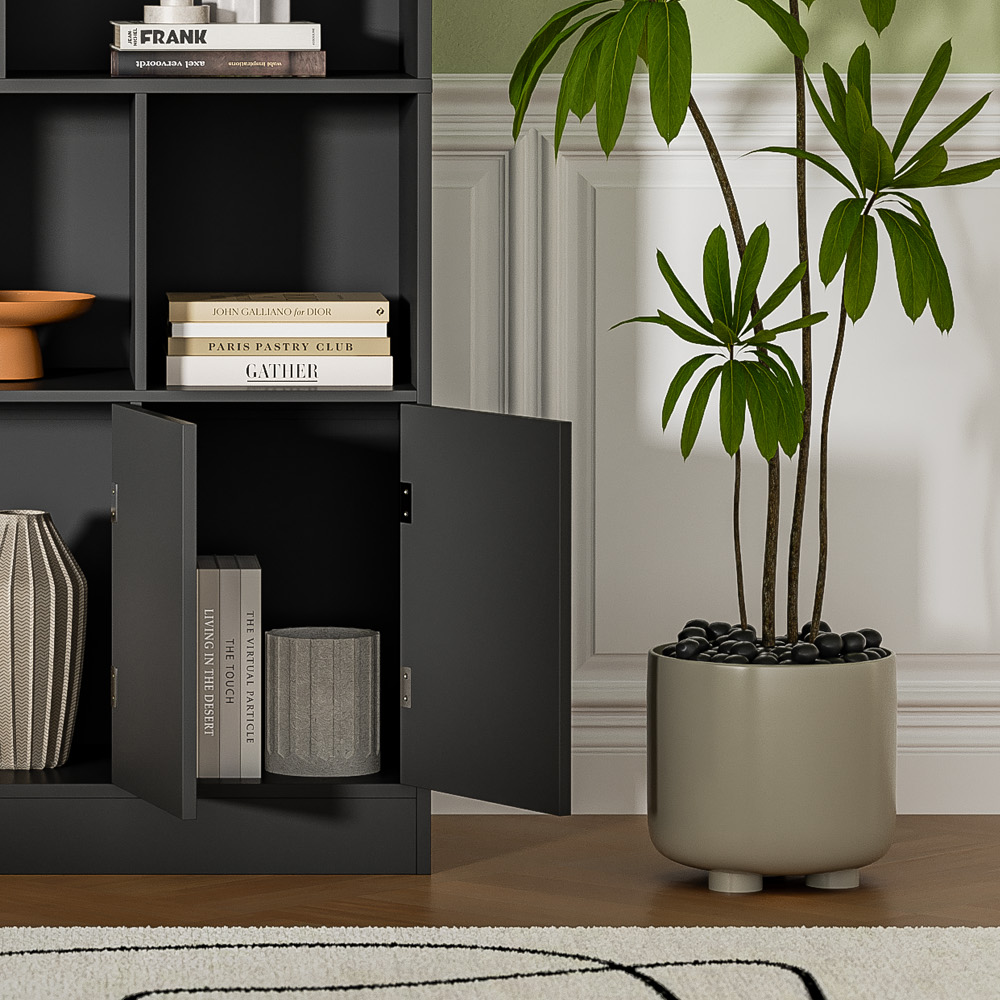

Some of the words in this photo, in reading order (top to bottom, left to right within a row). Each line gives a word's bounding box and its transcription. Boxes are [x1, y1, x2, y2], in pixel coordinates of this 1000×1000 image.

[140, 29, 207, 44] FRANK
[136, 60, 182, 68] vervoordt
[185, 60, 205, 68] axel
[212, 308, 239, 316] JOHN
[241, 308, 292, 316] GALLIANO
[294, 308, 305, 317] for
[307, 308, 332, 316] DIOR
[208, 343, 250, 351] PARIS
[256, 343, 309, 351] PASTRY
[316, 343, 353, 351] CLUB
[246, 363, 318, 378] GATHER
[204, 609, 214, 649] LIVING
[246, 610, 254, 633] THE
[204, 653, 214, 665] IN
[225, 638, 235, 660] THE
[246, 637, 254, 686] VIRTUAL
[204, 668, 214, 691] THE
[225, 664, 235, 704] TOUCH
[204, 694, 214, 737] DESERT
[246, 691, 254, 743] PARTICLE
